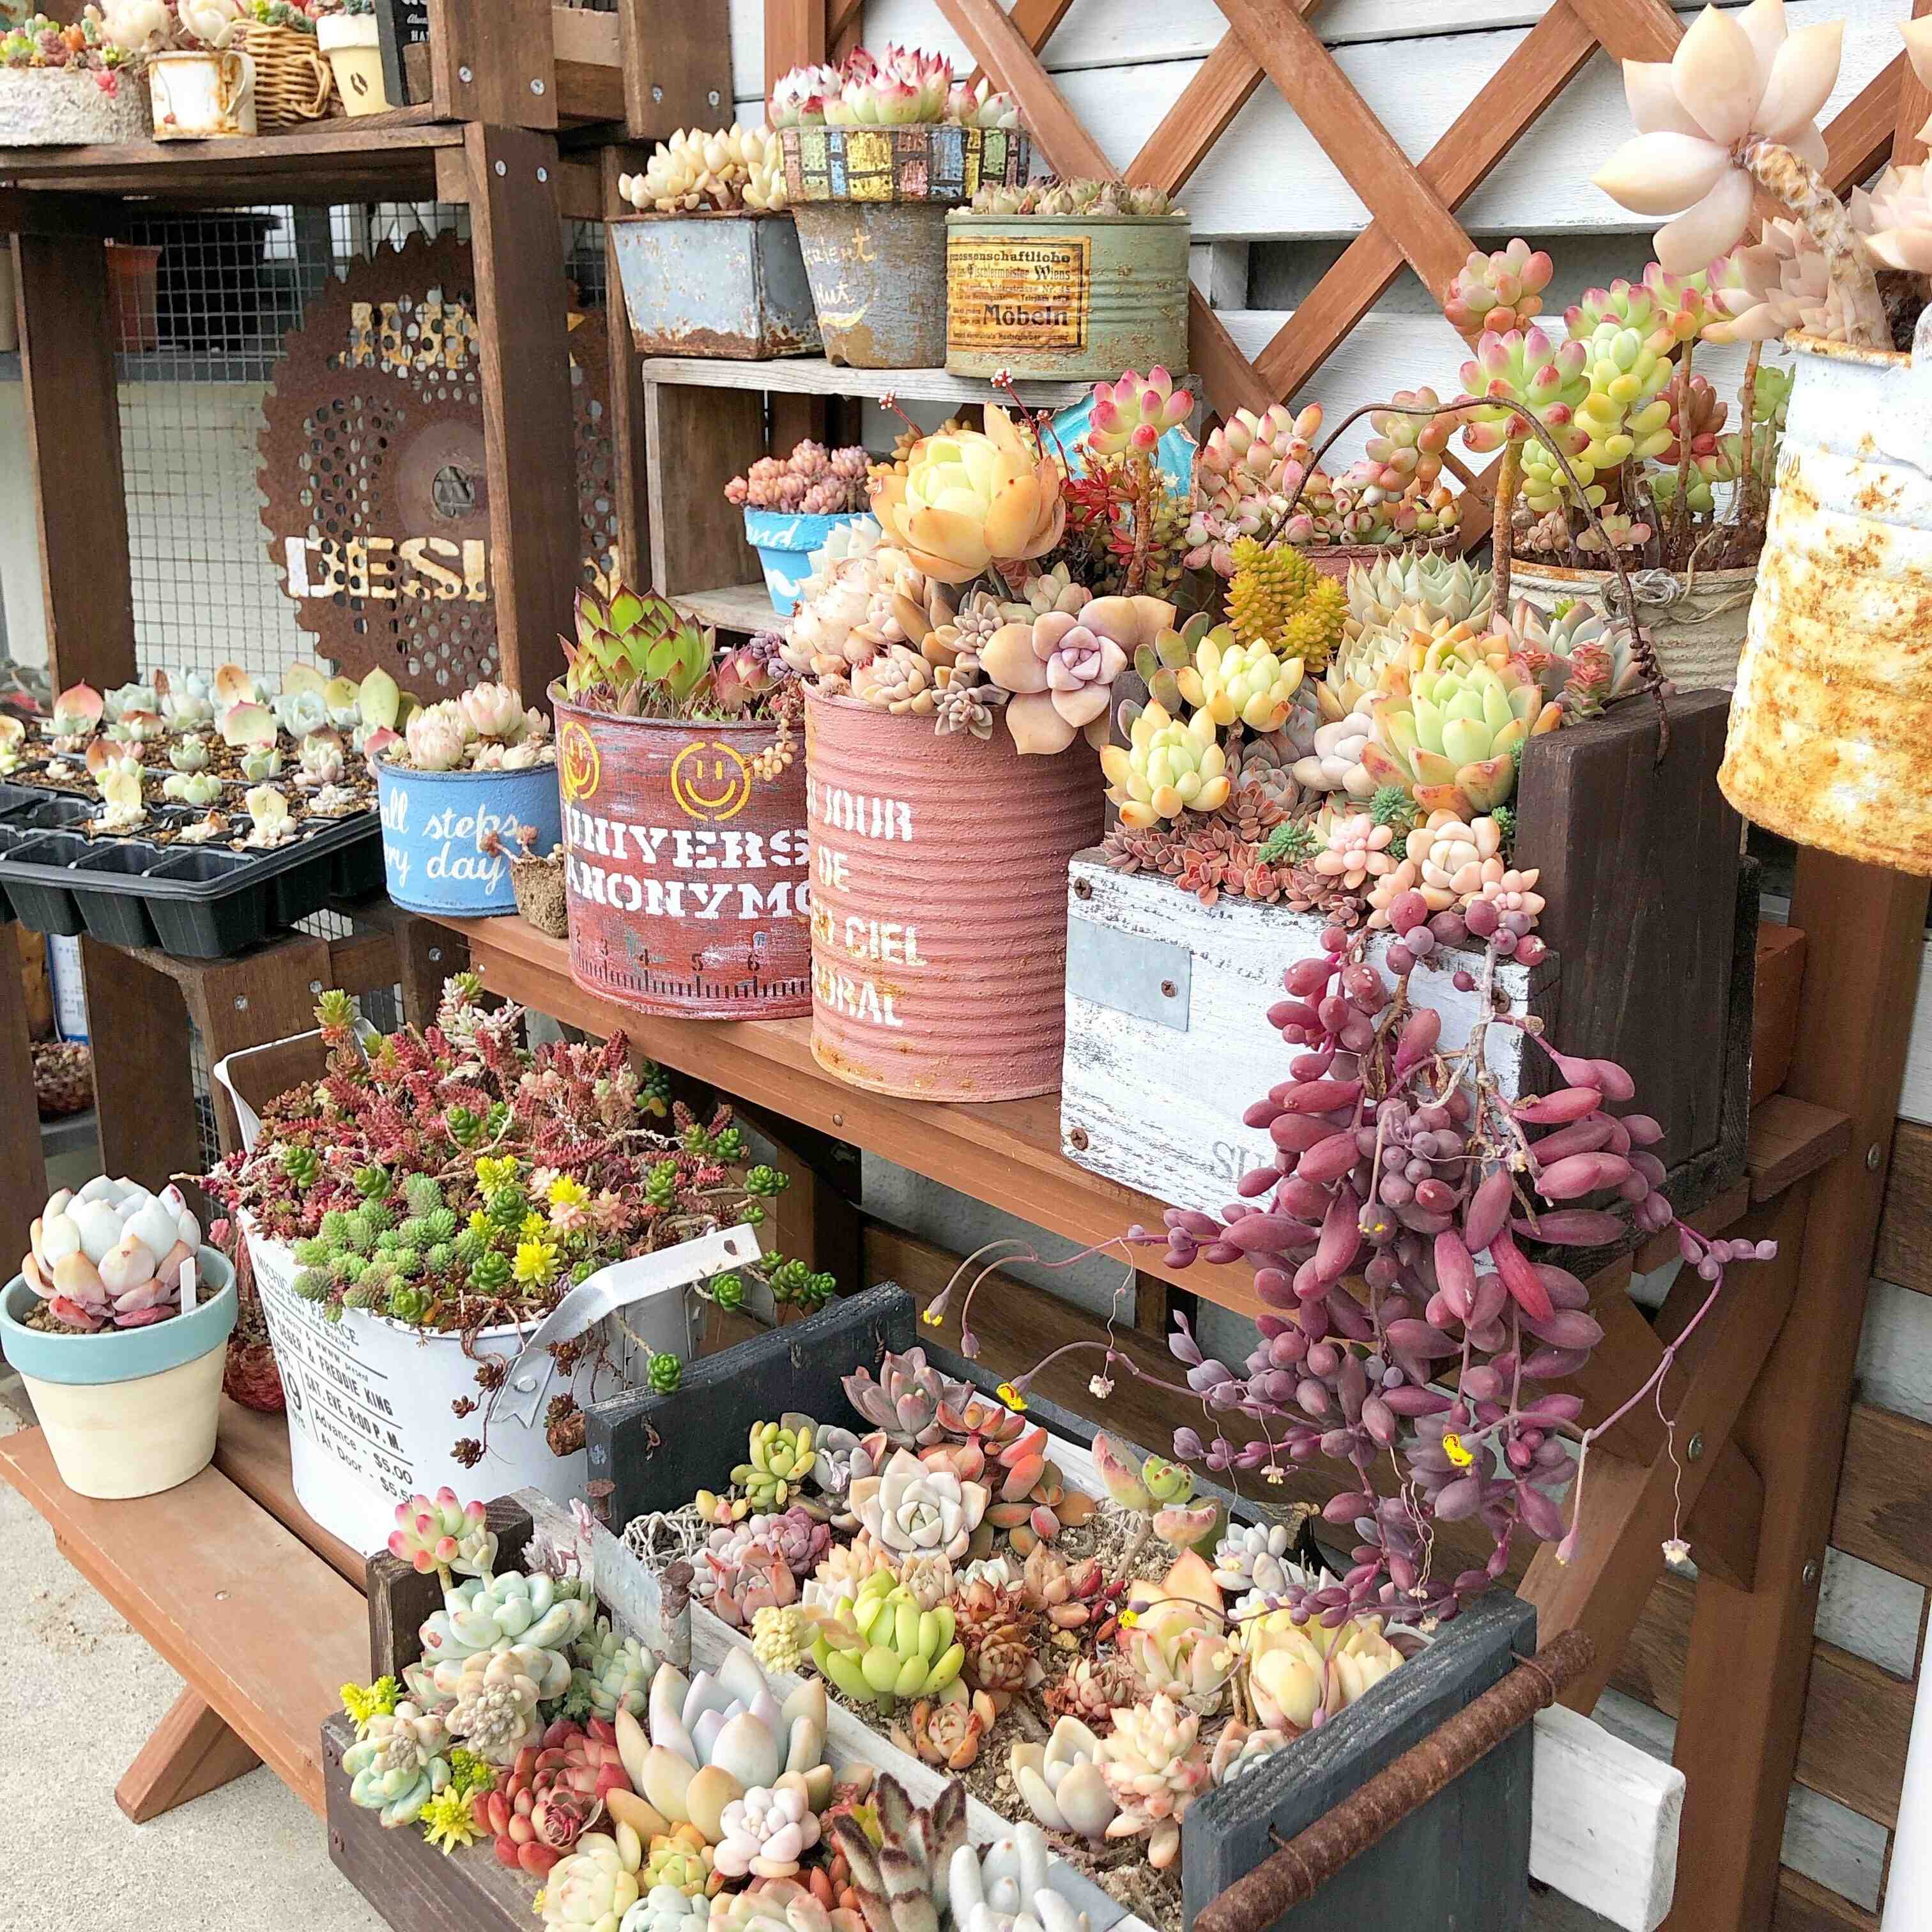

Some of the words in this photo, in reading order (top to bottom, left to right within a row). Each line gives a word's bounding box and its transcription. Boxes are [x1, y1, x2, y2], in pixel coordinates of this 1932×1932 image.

[983, 303, 1069, 326] Möbeln
[422, 802, 521, 854] steps
[824, 785, 913, 843] JOUR
[426, 841, 507, 895] day
[318, 1354, 361, 1397] FREDDIE
[362, 1385, 394, 1416] KING
[312, 1406, 358, 1452] Advance
[371, 1449, 413, 1485] $5.00
[335, 1443, 364, 1476] Door
